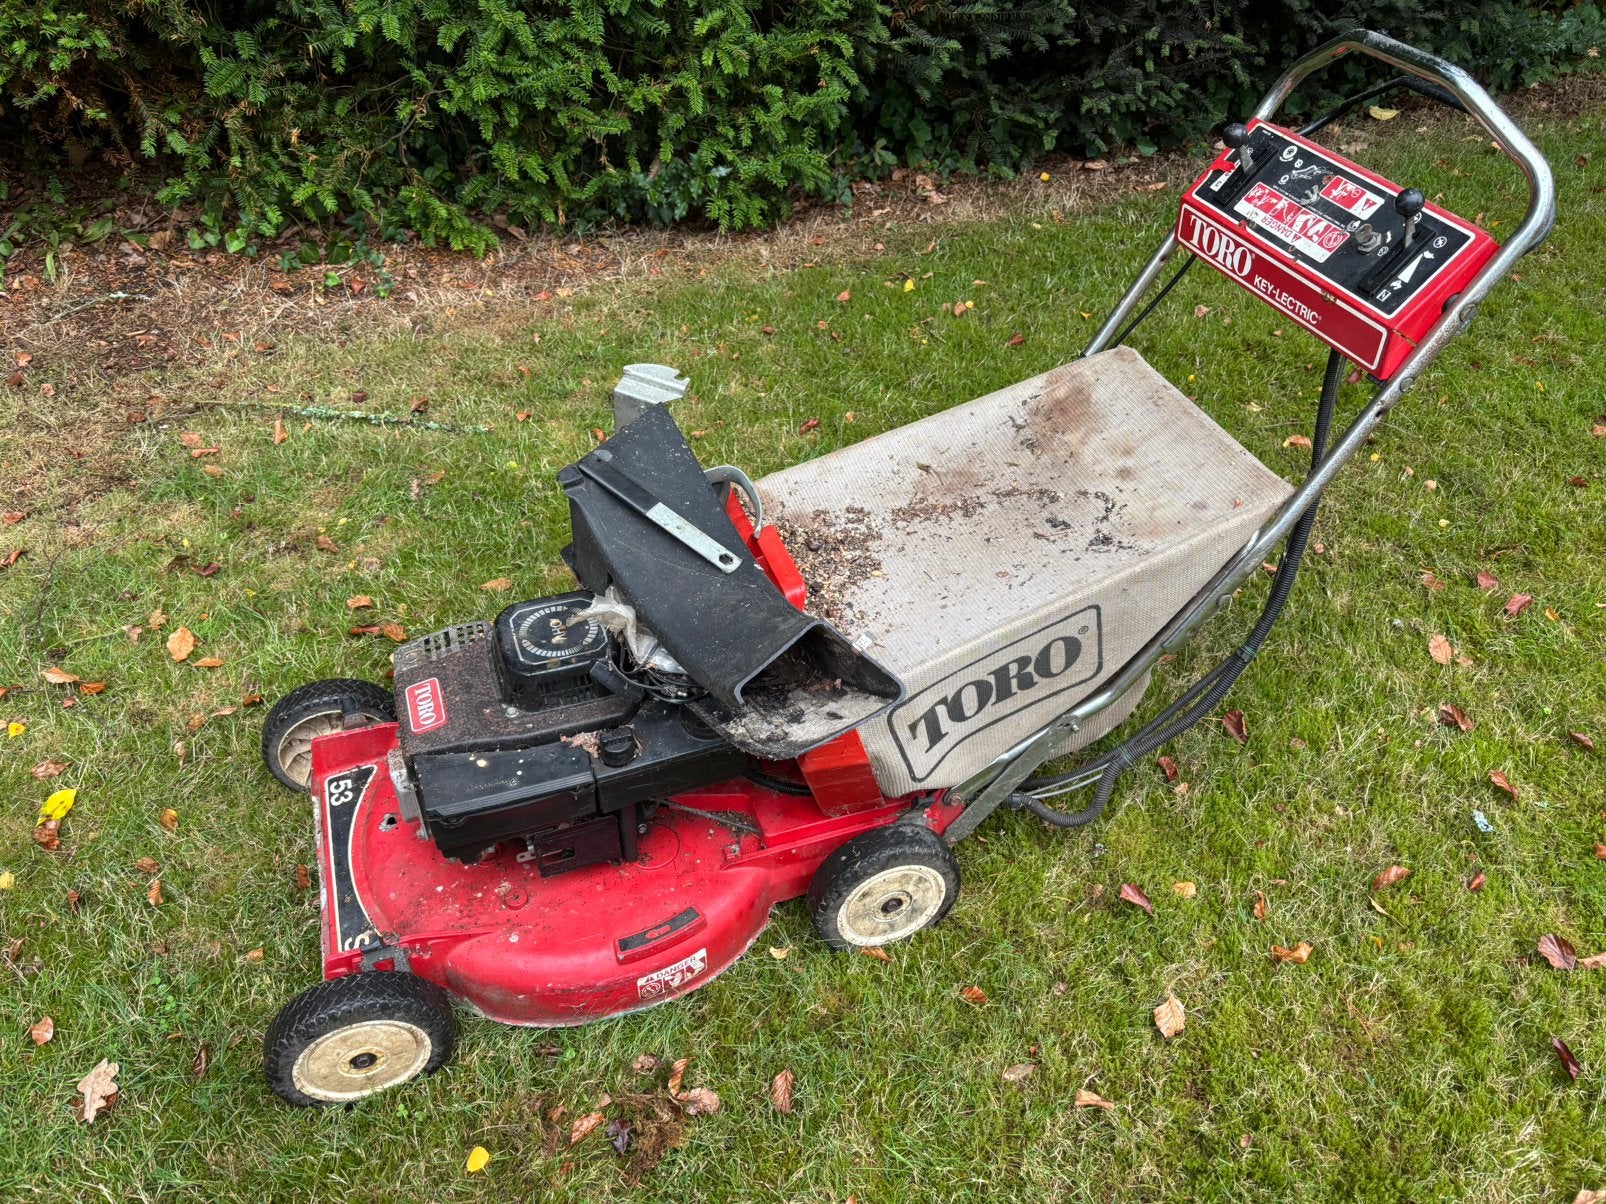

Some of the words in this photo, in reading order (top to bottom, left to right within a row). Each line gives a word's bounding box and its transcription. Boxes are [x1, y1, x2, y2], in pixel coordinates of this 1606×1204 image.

[1261, 214, 1293, 240] DANGER
[1189, 214, 1252, 277] TORO
[1253, 274, 1319, 325] KEY-LECTRIC
[415, 683, 436, 724] TORO
[329, 779, 354, 807] 53
[656, 956, 697, 979] DANGER
